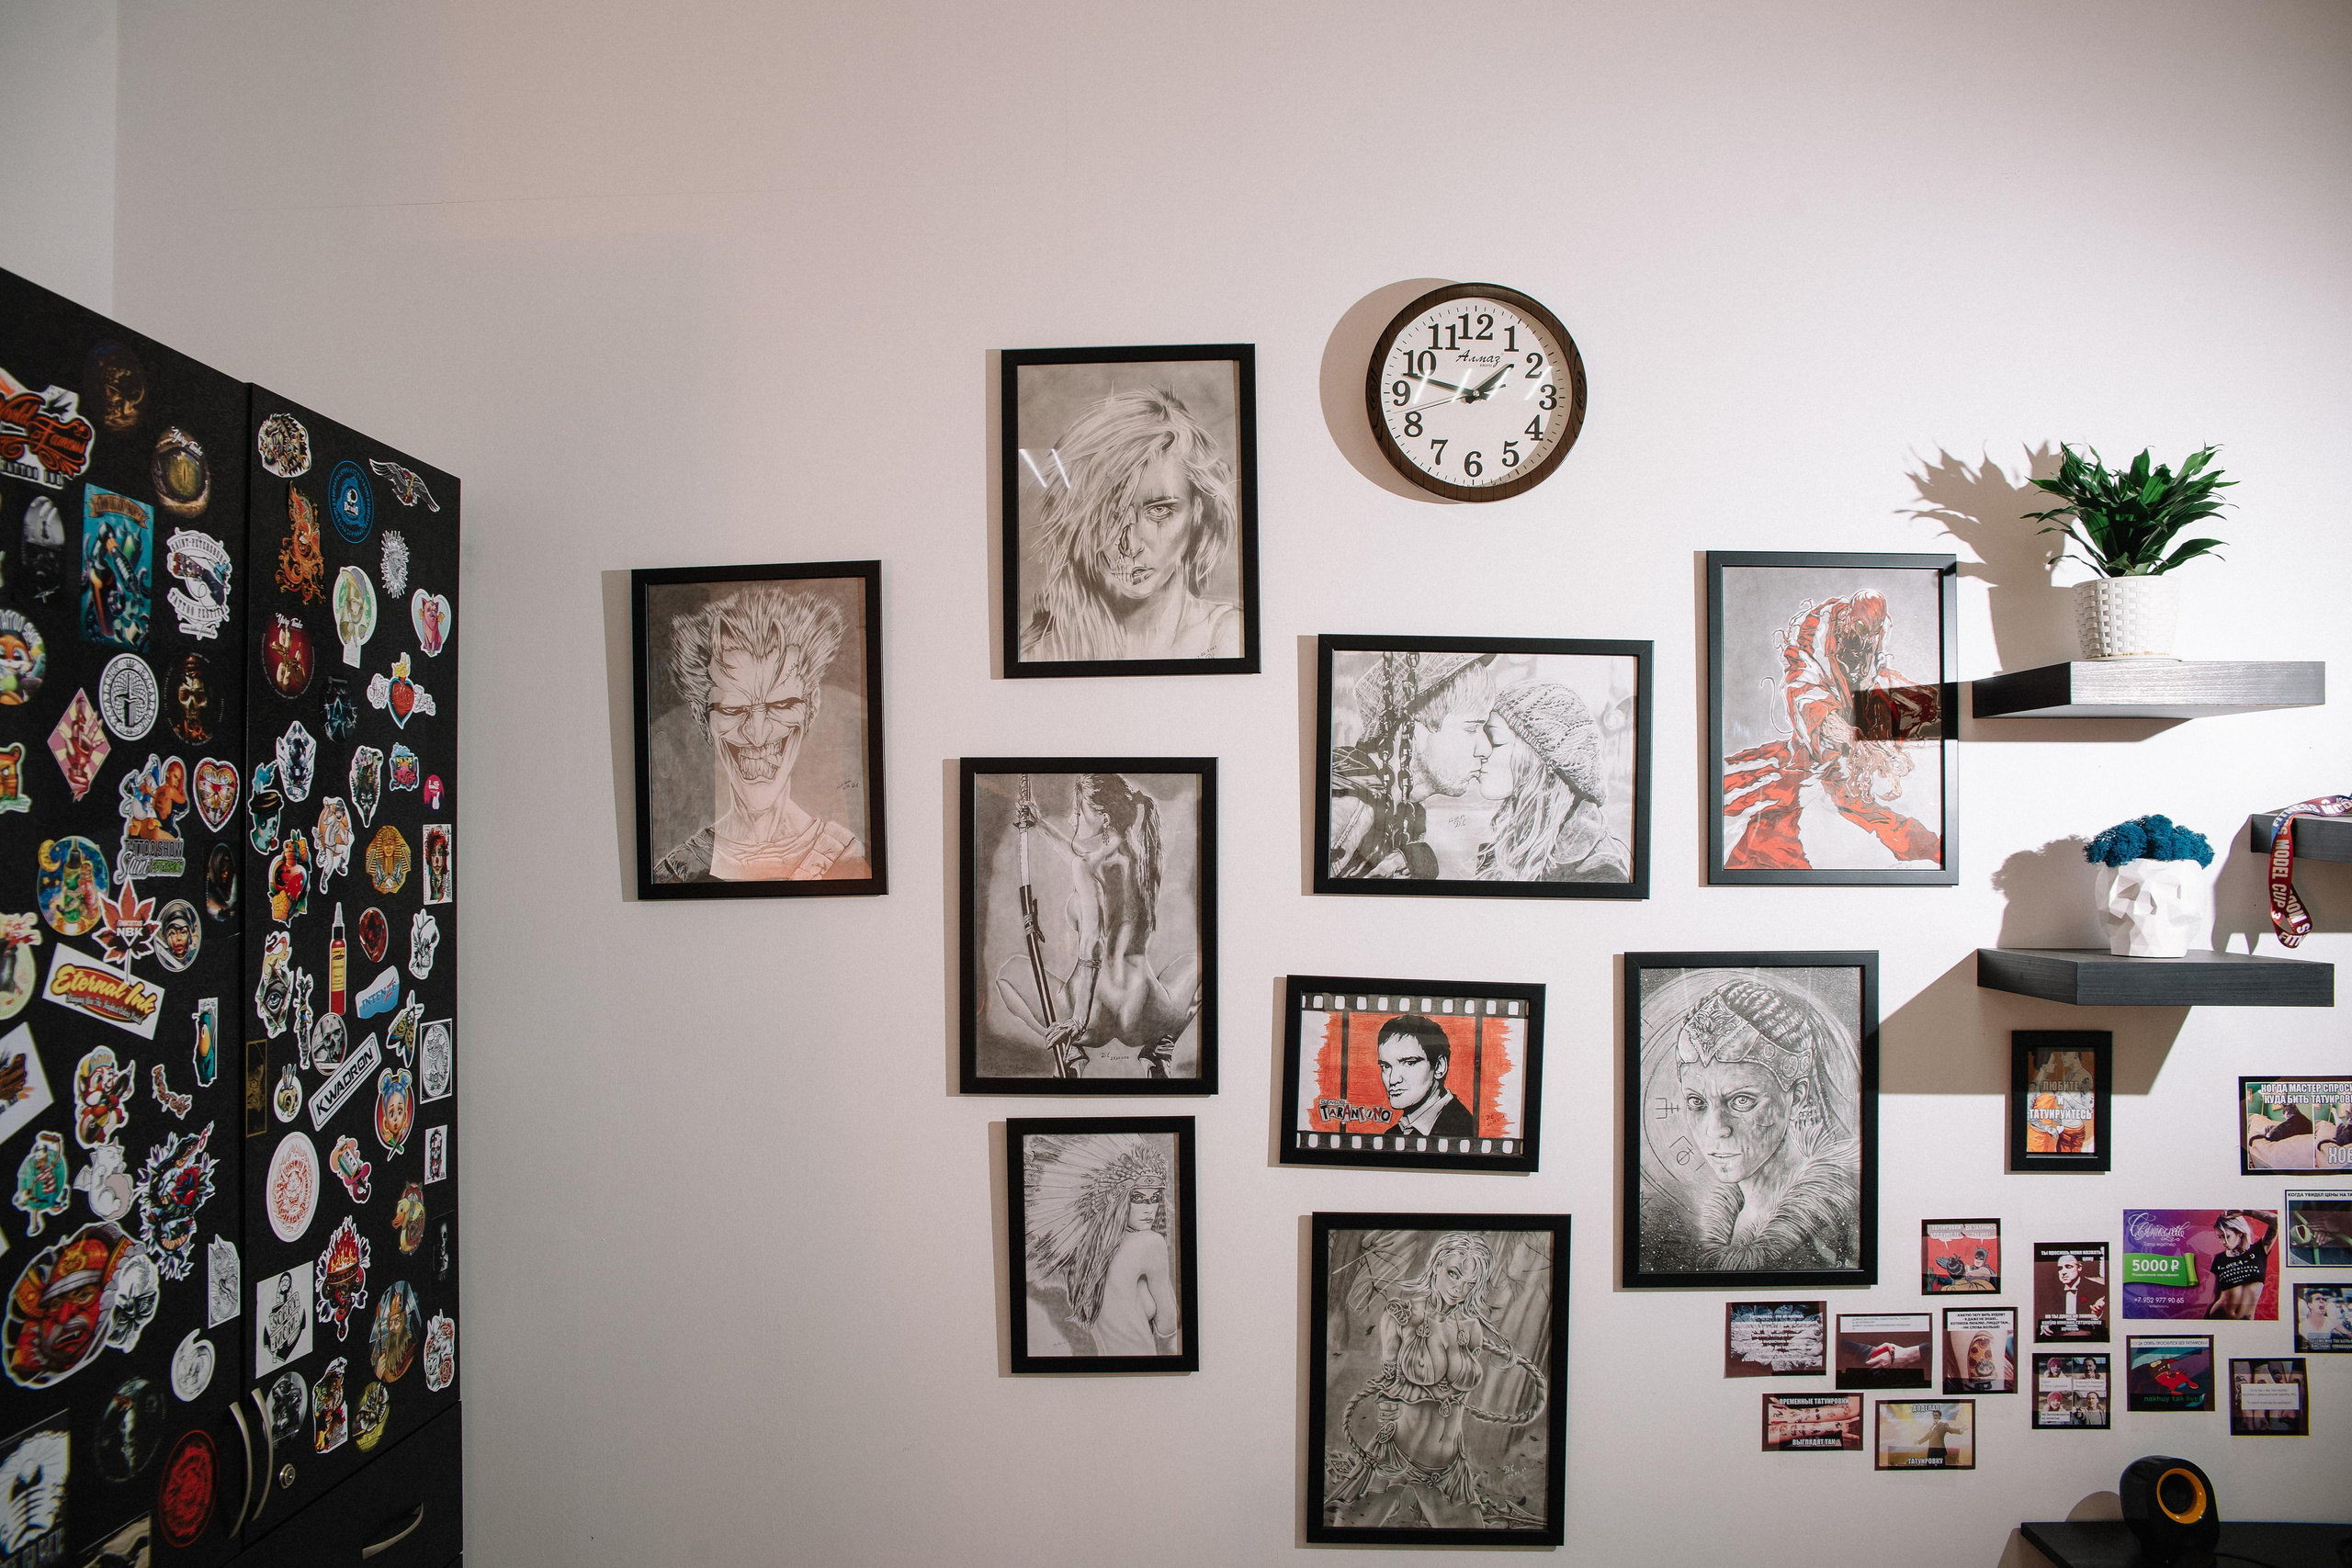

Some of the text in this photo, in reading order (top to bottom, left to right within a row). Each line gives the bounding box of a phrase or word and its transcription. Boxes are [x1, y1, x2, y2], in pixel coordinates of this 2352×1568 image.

[1428, 323, 1461, 350] 11
[1458, 313, 1494, 341] 12
[1504, 325, 1520, 352] 1
[1403, 350, 1437, 377] 10
[1455, 349, 1501, 367] Алмаз
[1525, 353, 1544, 378] 2
[1392, 379, 1411, 406] 9
[1539, 384, 1558, 411] 3
[1404, 412, 1423, 438] 8
[1524, 414, 1544, 441] 4
[1430, 438, 1449, 466] 7
[1464, 451, 1483, 478] 6
[1501, 441, 1520, 468] 5
[169, 591, 195, 616] TATTOO
[2271, 839, 2290, 880] MODEL
[2271, 883, 2288, 908] CUP
[51, 964, 157, 1014] Eternal Ink
[361, 976, 399, 1010] INTENZE
[315, 1049, 373, 1118] KWADRON
[2042, 1080, 2079, 1092] ЛЮБИТЕ
[2261, 1084, 2288, 1094] КОГДА
[2289, 1083, 2322, 1093] МАСТЕР
[2057, 1094, 2064, 1105] И
[2265, 1094, 2352, 1104] КУДА БИТЬ ТАТУИРОВ
[1320, 1104, 1391, 1122] TARANTINO
[2132, 1259, 2168, 1272] 5000
[271, 1293, 300, 1330] SORRY
[275, 1318, 298, 1348] MOM
